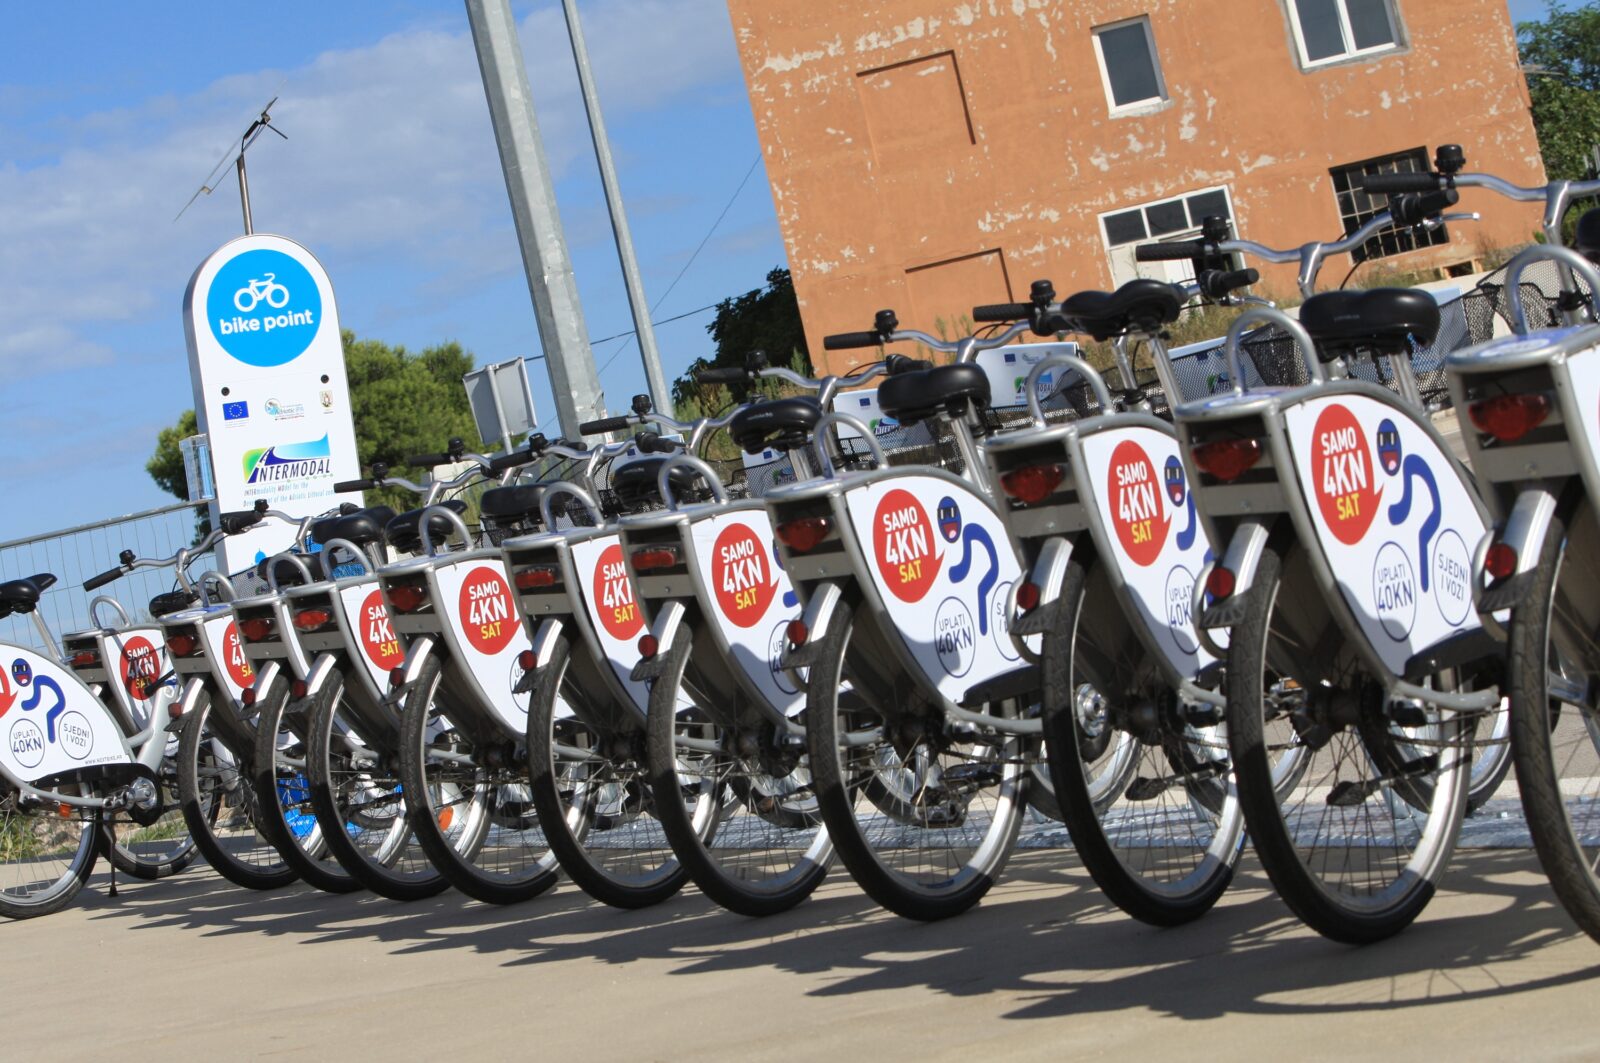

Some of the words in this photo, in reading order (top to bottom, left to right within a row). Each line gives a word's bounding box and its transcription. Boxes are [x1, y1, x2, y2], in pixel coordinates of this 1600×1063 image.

[219, 317, 261, 335] bike
[264, 309, 314, 332] point
[1321, 426, 1357, 456] SAMO
[247, 446, 331, 484] INTERMODAL
[1116, 460, 1147, 486] SAMO
[1323, 449, 1367, 498] 4KN
[1118, 482, 1158, 523] 4KN
[1336, 493, 1360, 521] SAT
[883, 506, 918, 532] SAMO
[1131, 520, 1152, 545] SAT
[721, 538, 754, 563] SAMO
[885, 524, 928, 566] 4KN
[602, 560, 627, 580] SAM
[723, 555, 764, 594] 4KN
[899, 560, 922, 584] SAT
[1377, 562, 1406, 583] UPLATI
[1438, 553, 1468, 584] SJEDNI
[468, 580, 500, 601] SAMO
[735, 588, 757, 610] SAT
[1169, 585, 1192, 601] UPLAT
[1378, 581, 1413, 613] 40KN
[1447, 577, 1464, 601] VOZI
[469, 595, 508, 626] 4KN
[614, 604, 634, 624] SAT
[938, 613, 965, 631] UPLATI
[1170, 601, 1192, 627] 40K
[369, 618, 396, 644] 4K
[481, 622, 502, 640] SAT
[938, 628, 972, 656] 40KN
[127, 645, 149, 660] SAMO
[380, 641, 399, 657] SAT
[127, 656, 155, 679] 4KN
[241, 665, 253, 677] SA
[13, 730, 37, 740] UPLATI
[63, 723, 90, 739] SJEDNI
[71, 735, 87, 748] VOZI
[13, 736, 42, 754] 40KN
